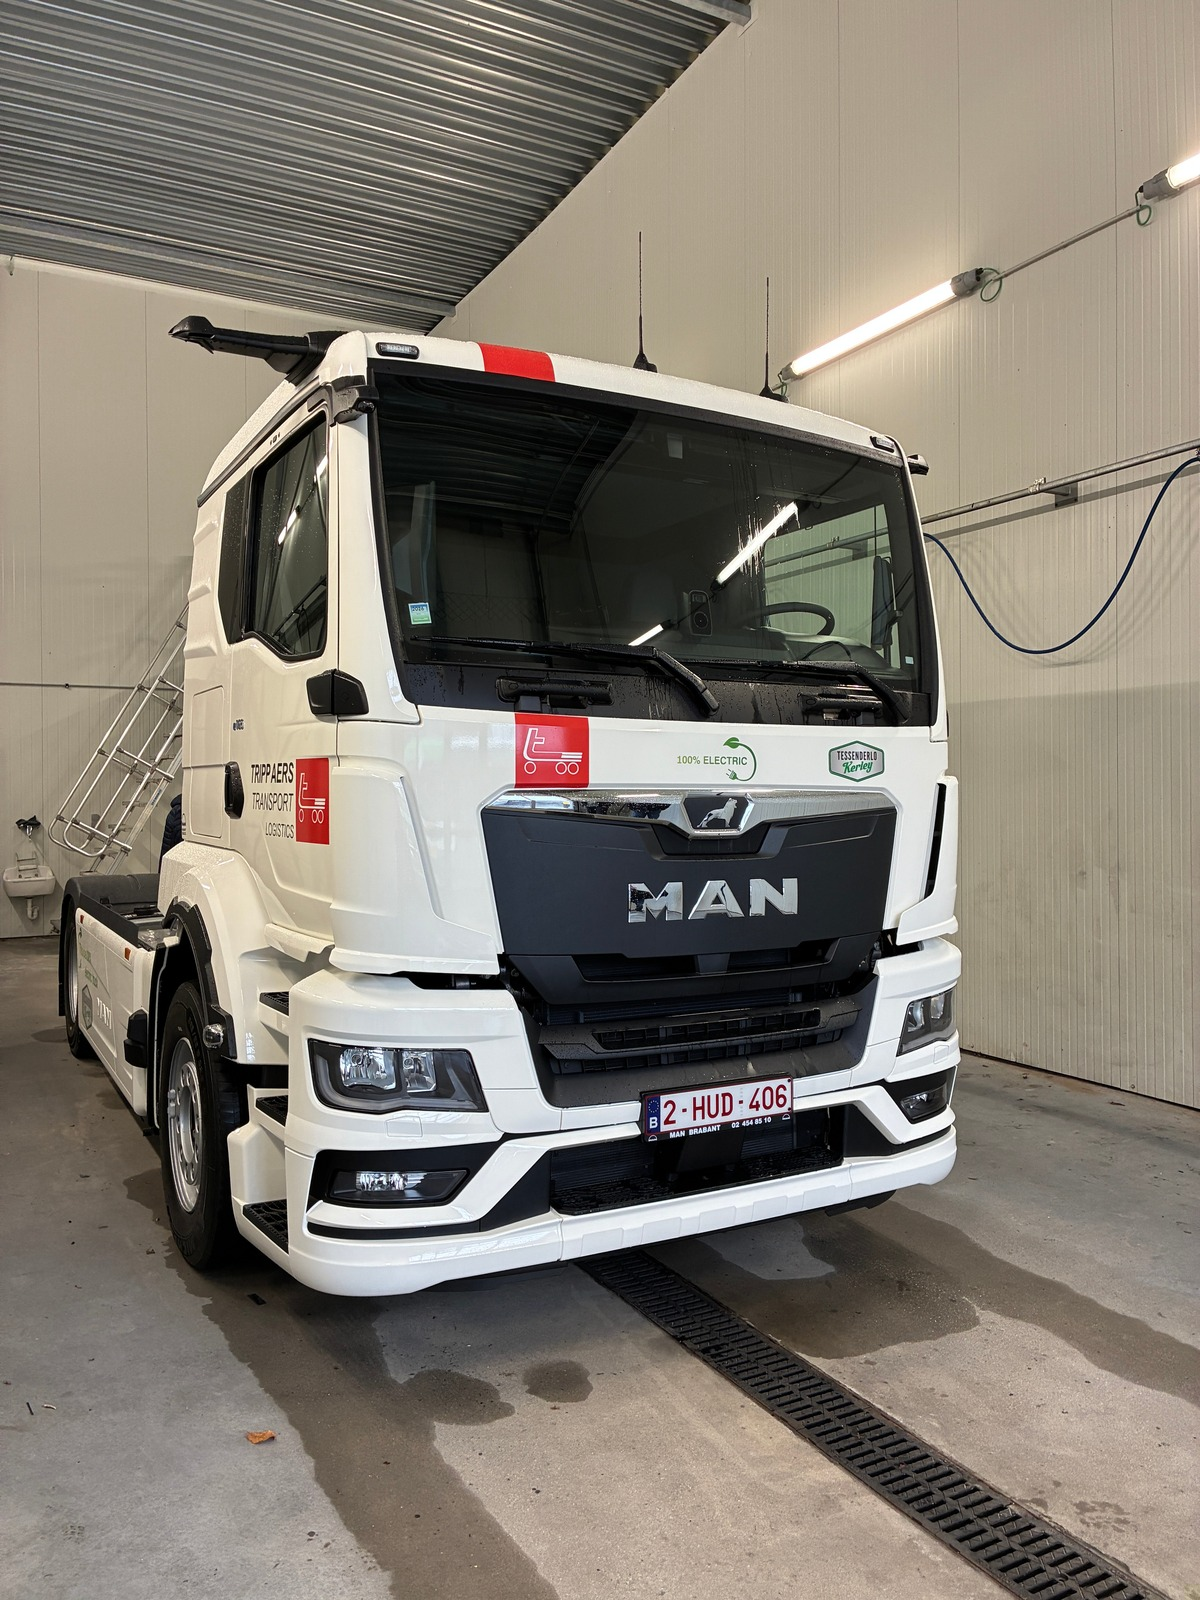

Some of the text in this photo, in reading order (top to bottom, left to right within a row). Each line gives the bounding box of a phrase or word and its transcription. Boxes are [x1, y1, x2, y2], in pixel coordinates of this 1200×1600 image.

[677, 756, 748, 766] 100% ELECTRIC
[837, 750, 878, 761] TESSENDERLO
[251, 762, 294, 784] TRIPPAERS
[842, 761, 873, 774] Kerley
[252, 792, 294, 812] TRANSPORT
[266, 822, 294, 838] LOGISTICS
[628, 878, 798, 923] MAN
[664, 1084, 787, 1126] 2-HUD-406
[650, 1116, 658, 1128] B
[688, 1124, 721, 1136] BRABANT
